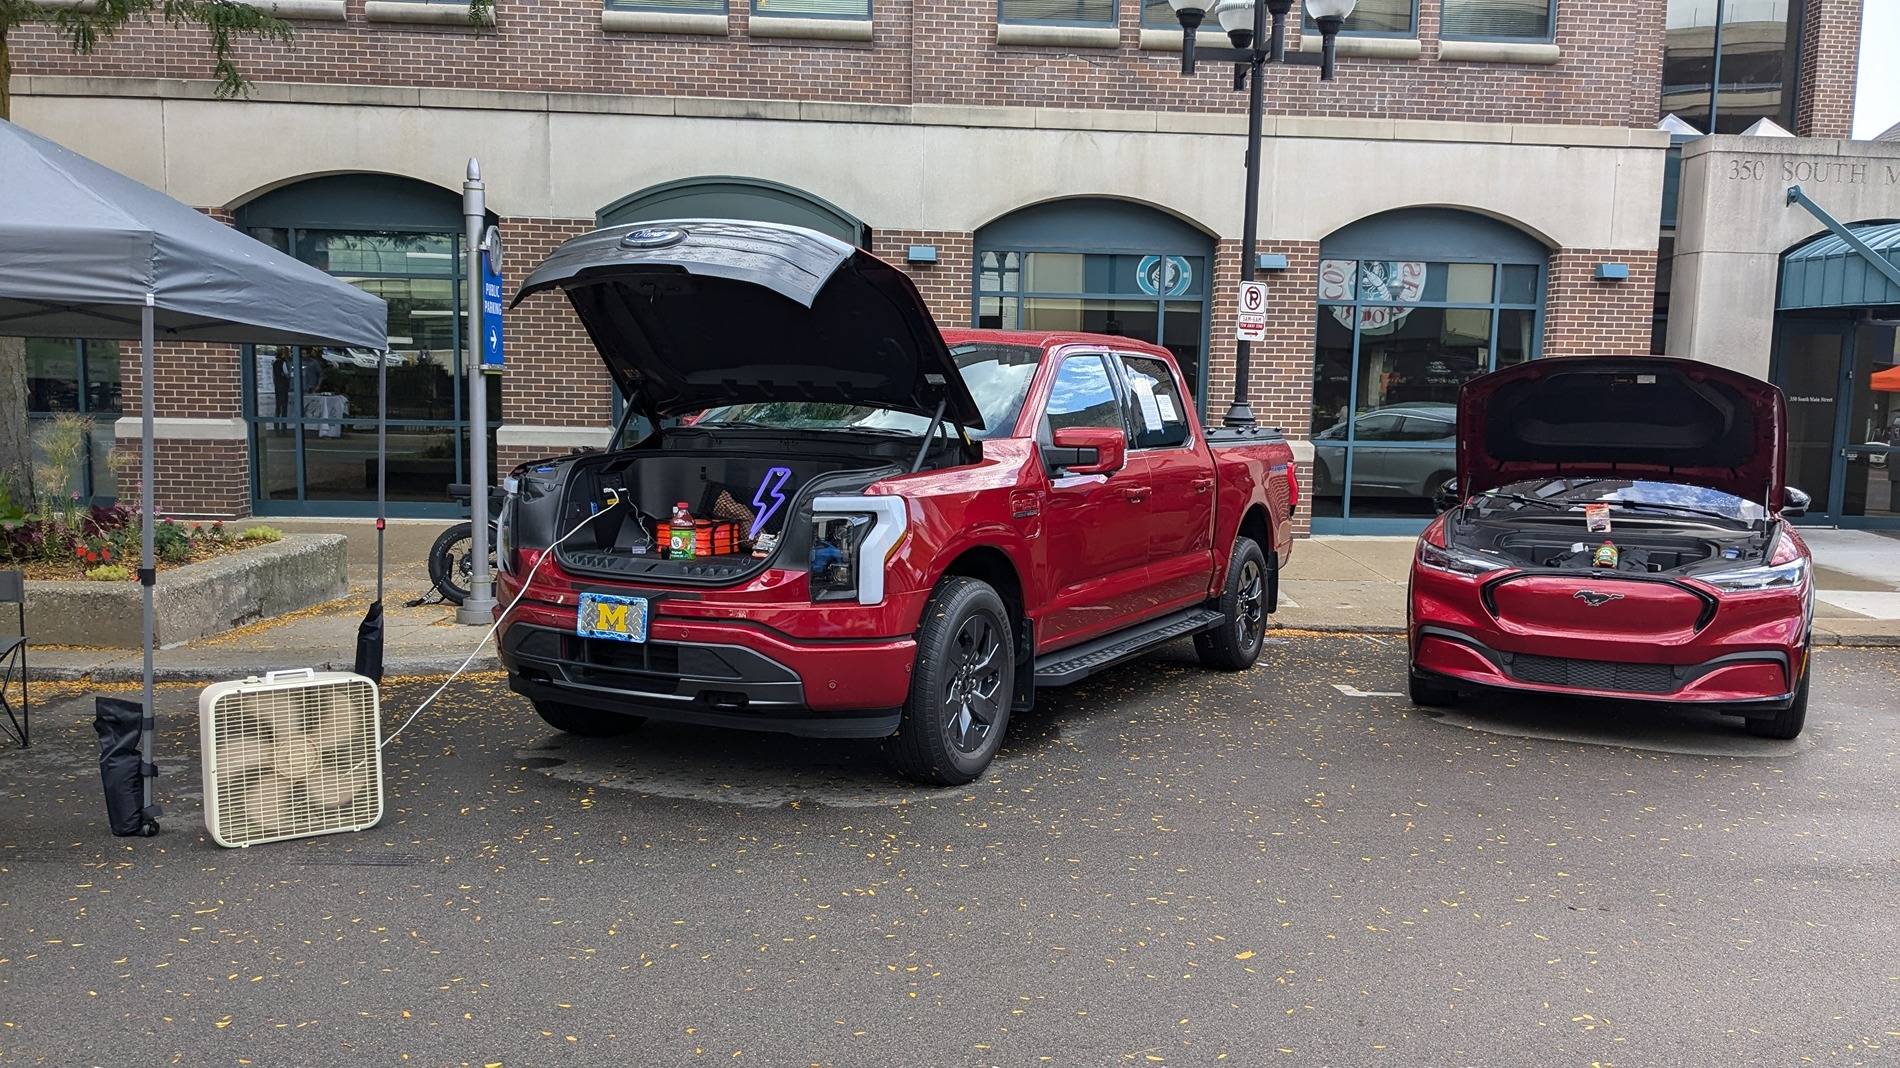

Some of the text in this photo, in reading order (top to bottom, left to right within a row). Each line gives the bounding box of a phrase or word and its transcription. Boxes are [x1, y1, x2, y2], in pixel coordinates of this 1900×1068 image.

[1729, 159, 1765, 181] 350
[1782, 160, 1868, 185] SOUTH
[485, 282, 500, 298] PUBLIC
[484, 300, 502, 316] PARKING
[596, 603, 628, 632] M
